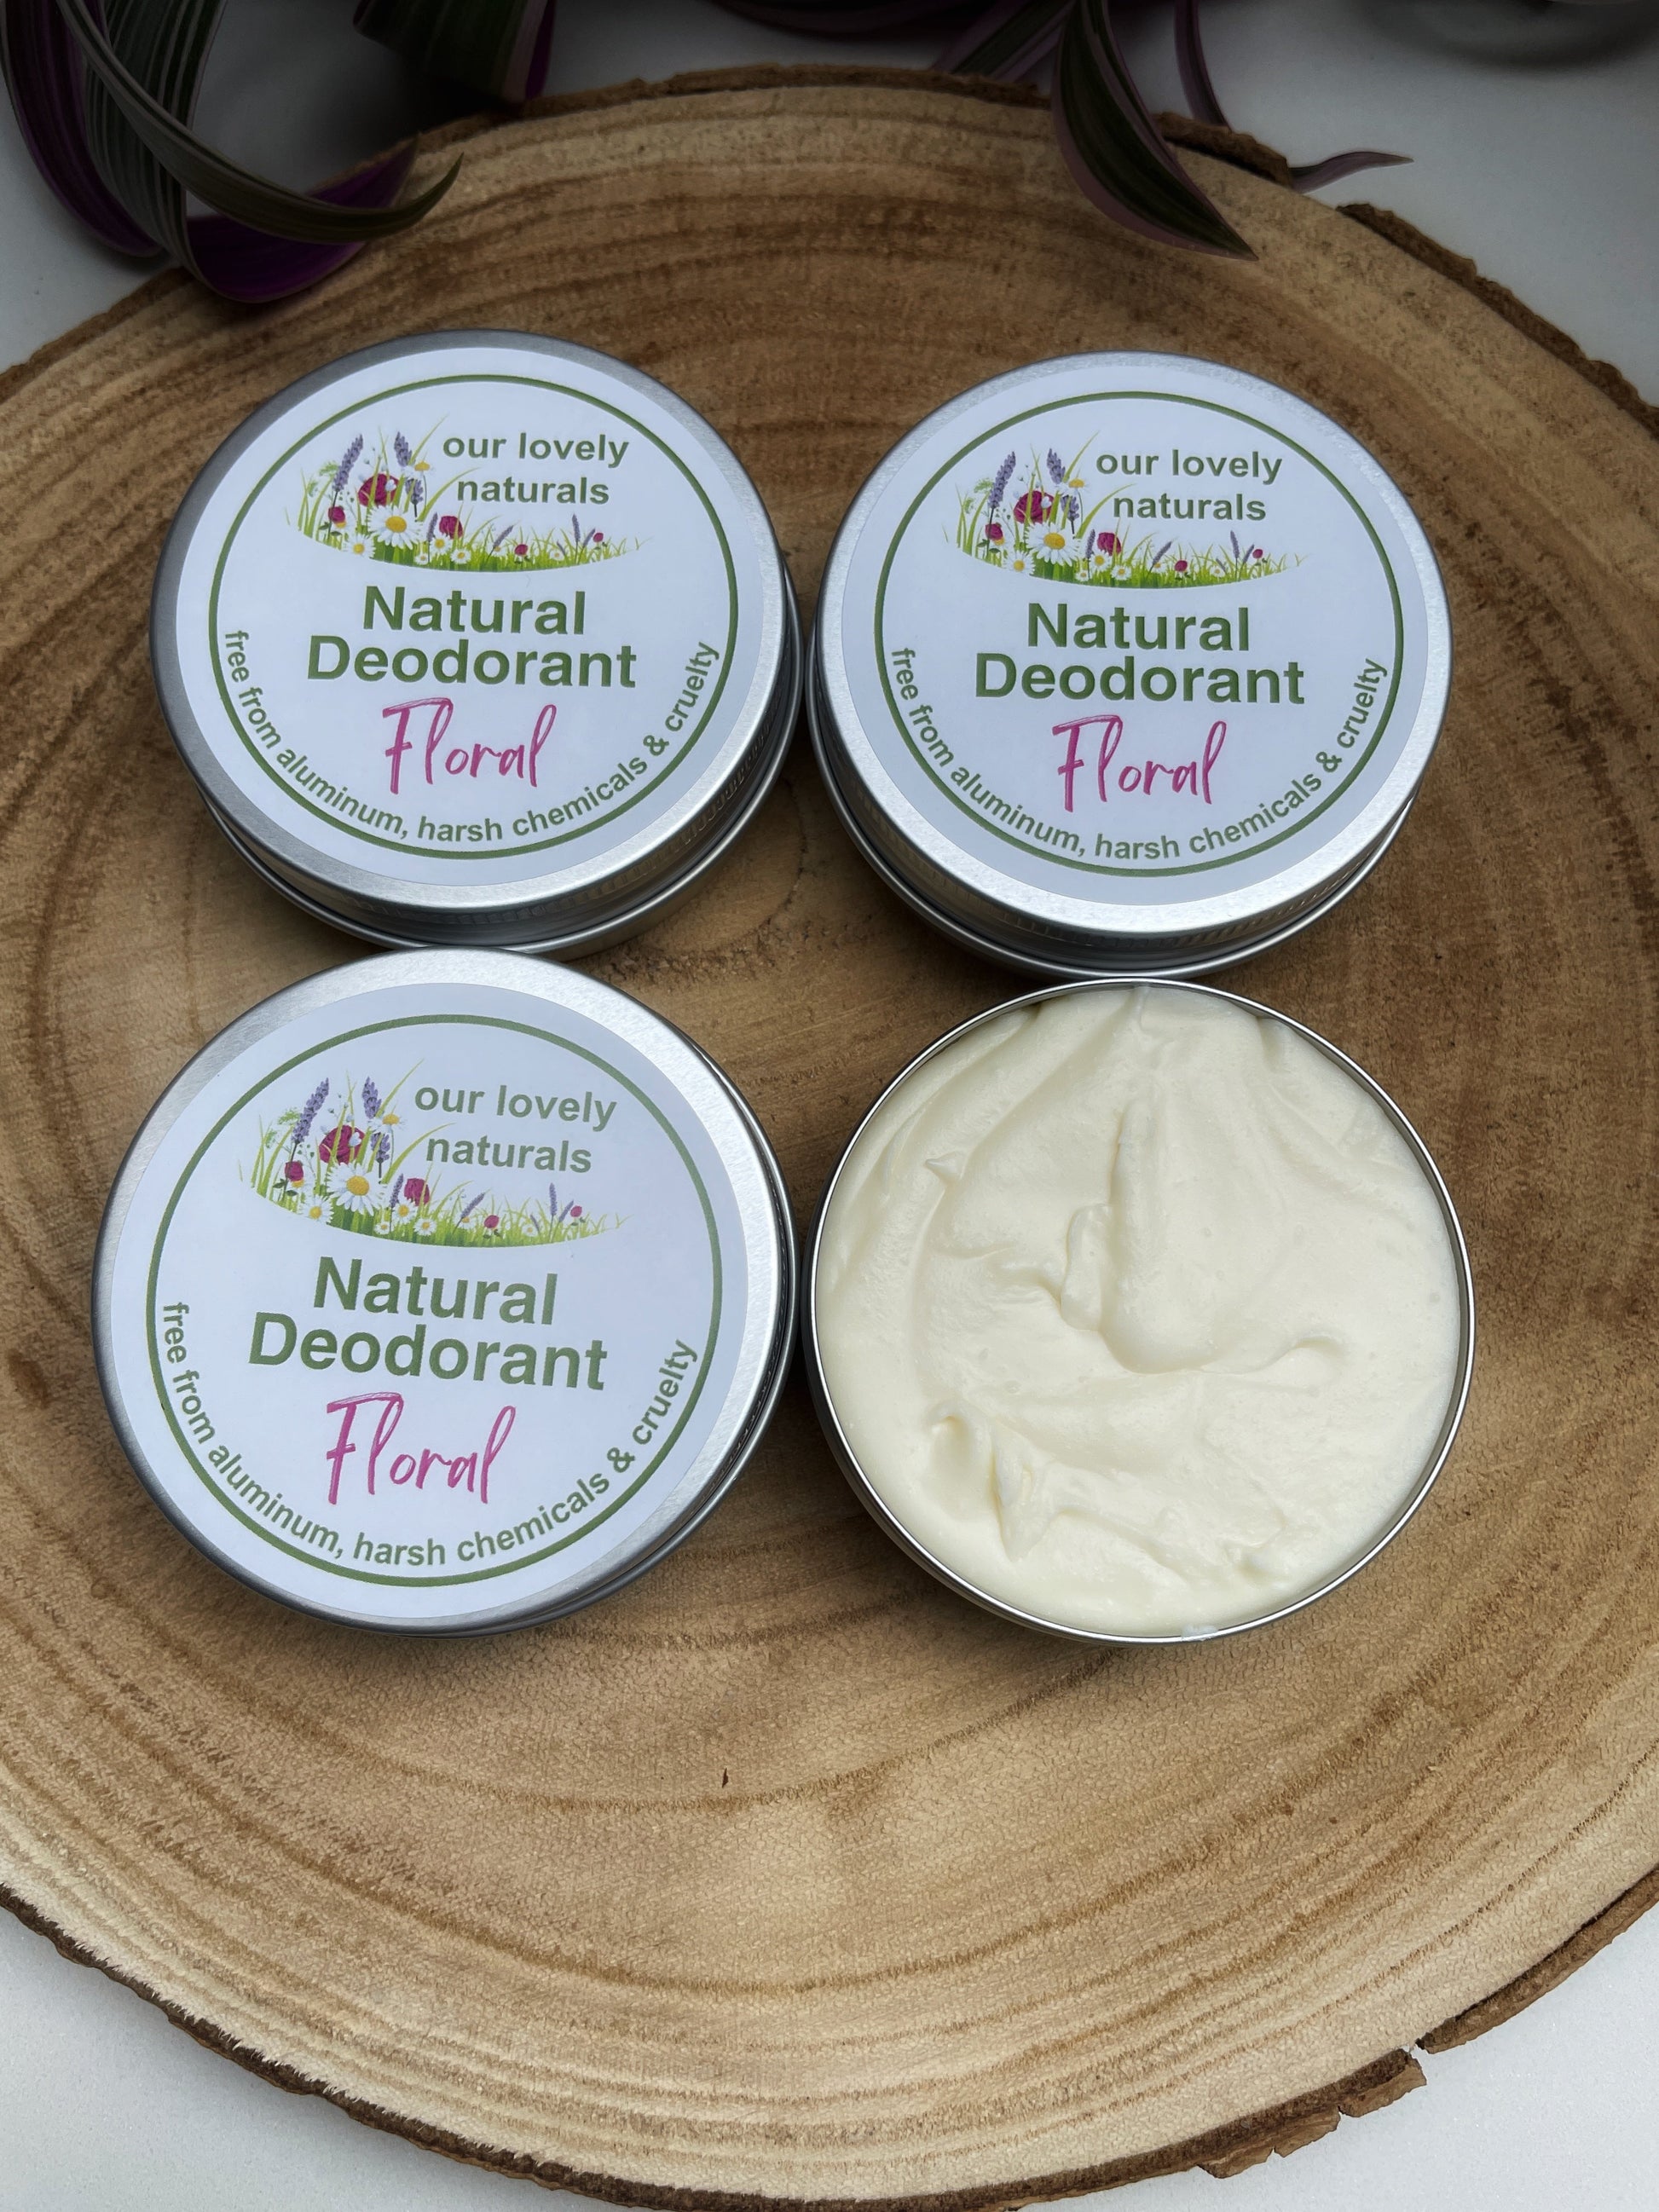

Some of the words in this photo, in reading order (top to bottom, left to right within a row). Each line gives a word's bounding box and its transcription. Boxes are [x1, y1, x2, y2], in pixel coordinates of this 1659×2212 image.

[442, 437, 506, 459] our
[518, 432, 629, 469] lovely
[1095, 453, 1159, 476] our
[1171, 449, 1283, 485] lovely
[457, 477, 610, 504] naturals
[1113, 494, 1266, 520] naturals
[362, 586, 586, 635] Natural
[1027, 603, 1249, 651] Natural
[307, 635, 637, 688] Deodorant
[976, 652, 1304, 704] Deodorant
[225, 630, 249, 682] free
[239, 689, 281, 750] from
[277, 749, 408, 839] aluminum,
[418, 817, 503, 841] harsh
[512, 758, 648, 836] chemicals
[644, 734, 669, 756] &
[665, 641, 720, 731] cruelty
[382, 697, 557, 794] Floral
[892, 647, 919, 700] free
[908, 704, 955, 768] from
[951, 767, 1085, 857] aluminum,
[1095, 834, 1180, 858] harsh
[1189, 775, 1322, 853] chemicals
[1316, 751, 1343, 773] &
[1337, 658, 1388, 749] cruelty
[1052, 714, 1227, 812] Floral
[414, 1086, 484, 1115] our
[497, 1085, 617, 1132] lovely
[425, 1137, 592, 1173] naturals
[314, 1256, 558, 1325] Natural
[164, 1302, 189, 1364] free
[248, 1312, 607, 1391] Deodorant
[173, 1372, 217, 1445] from
[632, 1339, 697, 1446] cruelty
[326, 1391, 517, 1505] Floral
[606, 1447, 635, 1473] &
[208, 1444, 344, 1559] aluminum,
[457, 1472, 610, 1561] chemicals
[353, 1532, 445, 1565] harsh
